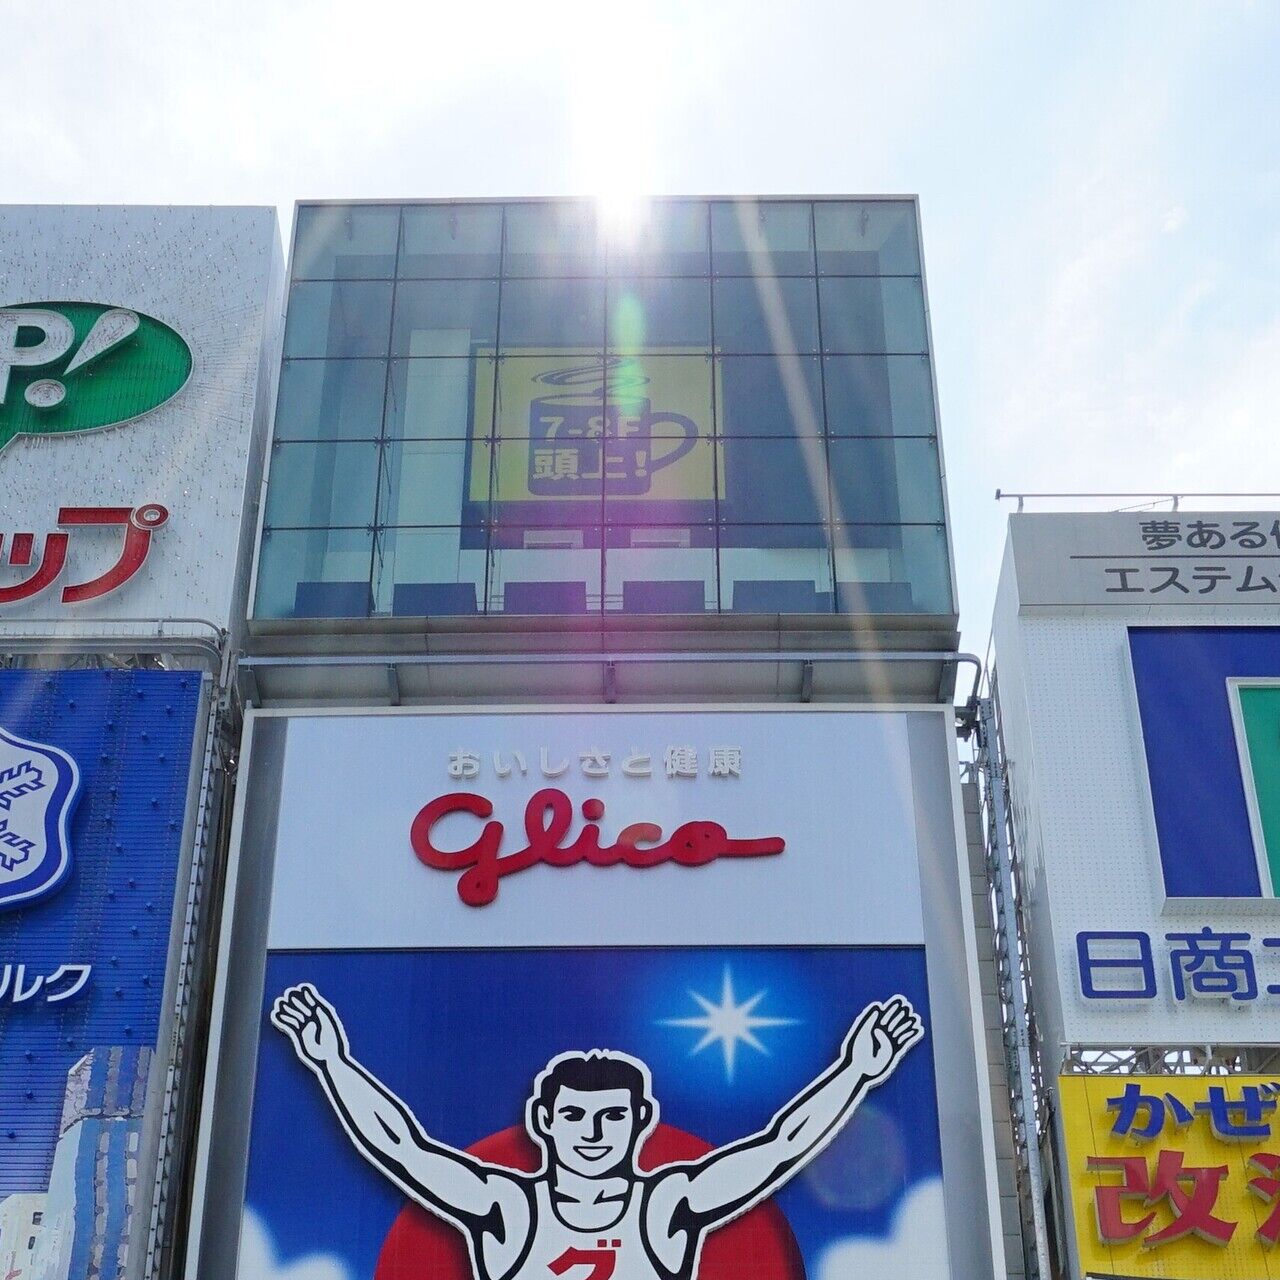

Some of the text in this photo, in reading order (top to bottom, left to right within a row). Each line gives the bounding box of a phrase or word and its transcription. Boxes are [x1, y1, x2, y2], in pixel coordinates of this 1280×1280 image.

[446, 744, 745, 779] おいしさと健康
